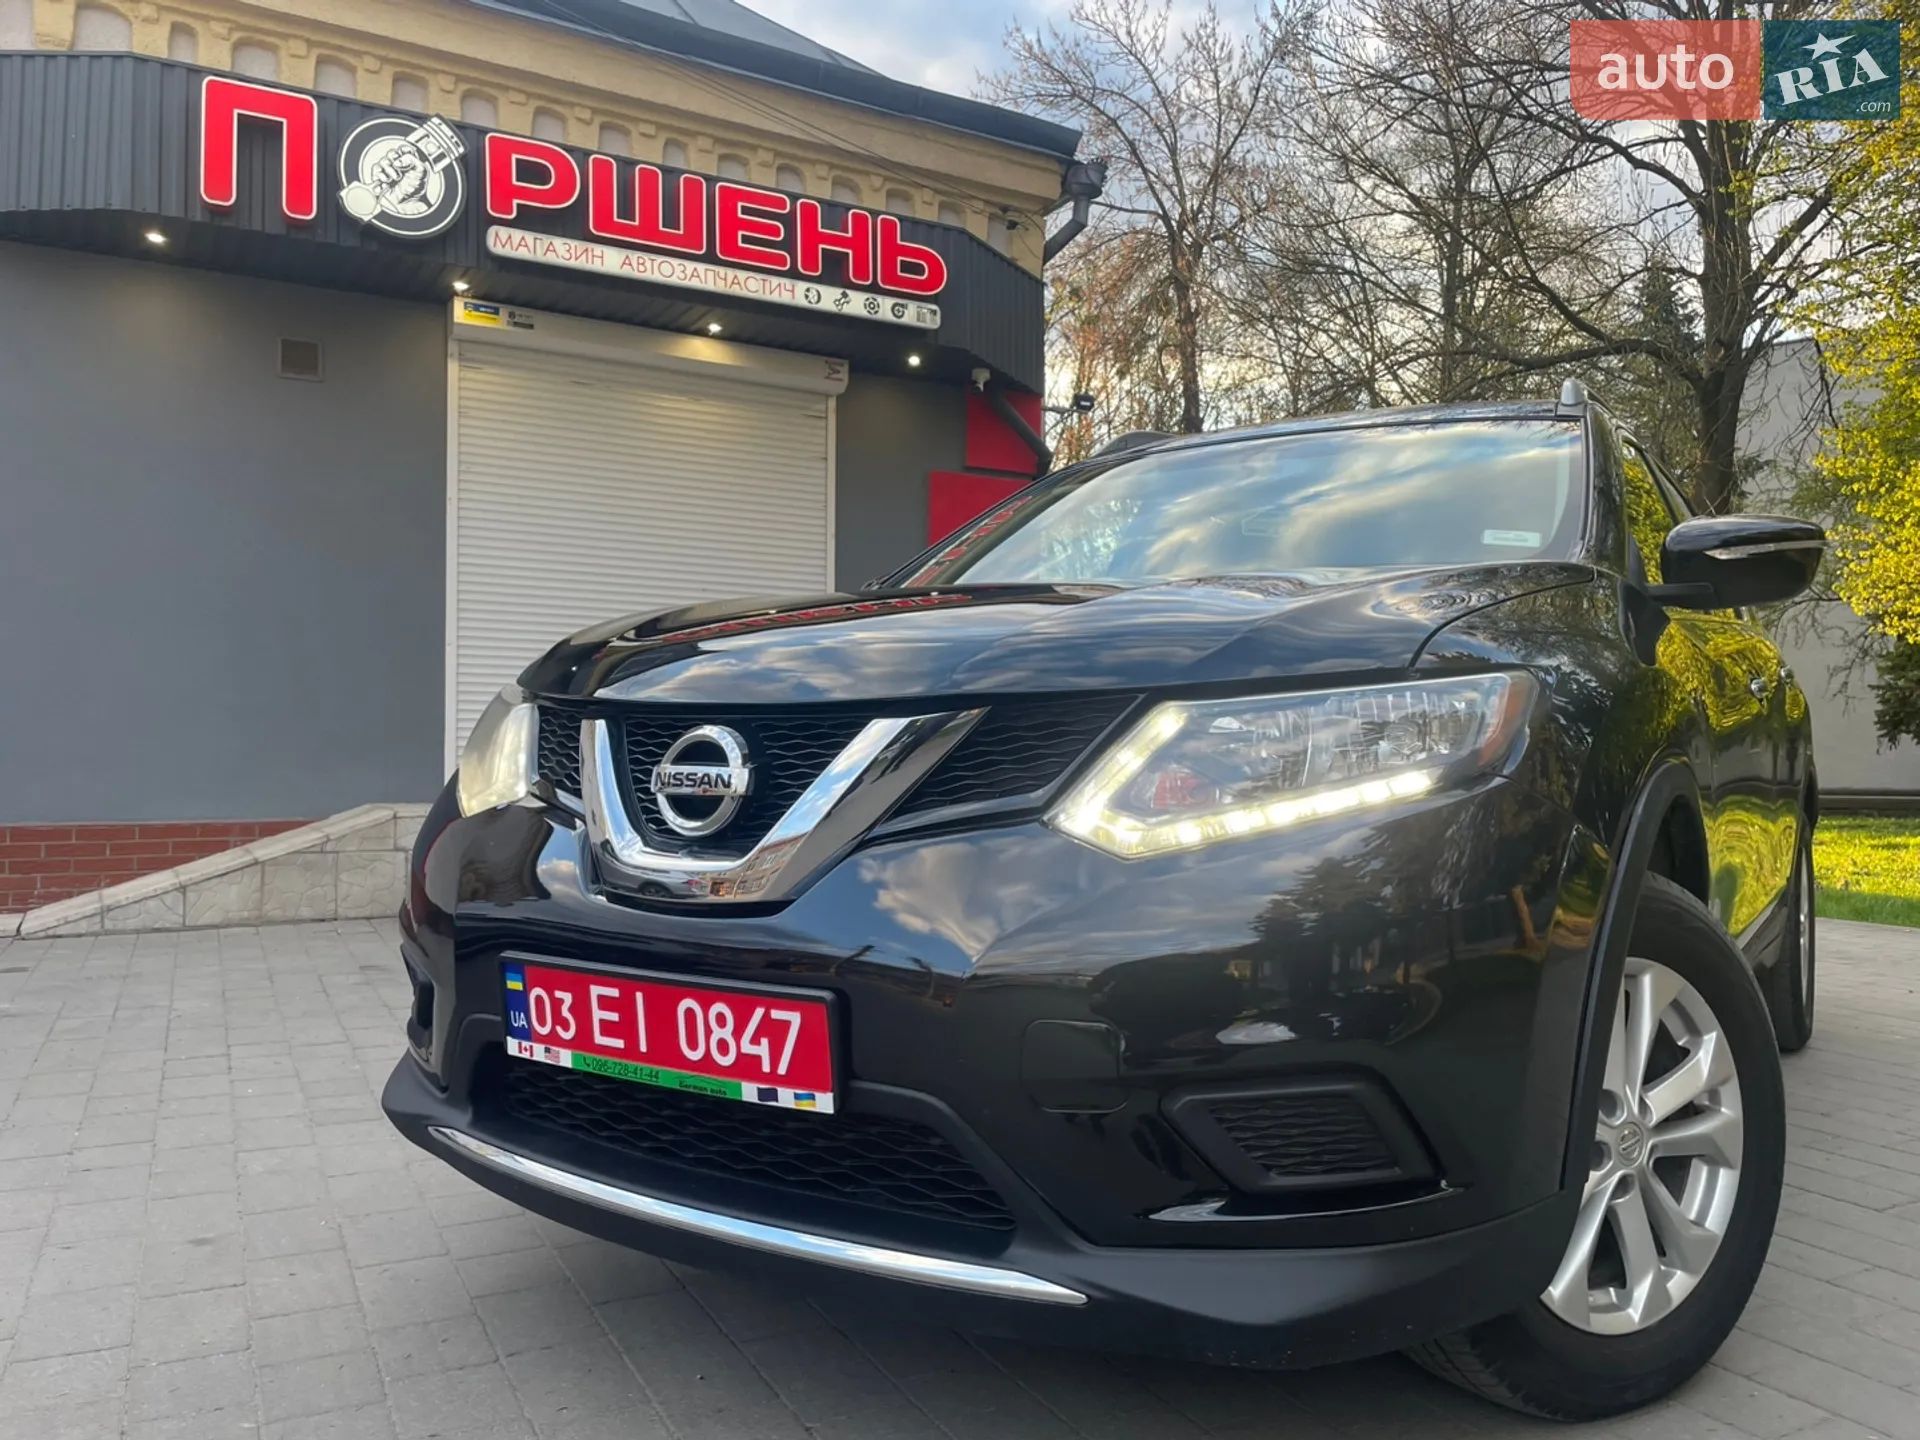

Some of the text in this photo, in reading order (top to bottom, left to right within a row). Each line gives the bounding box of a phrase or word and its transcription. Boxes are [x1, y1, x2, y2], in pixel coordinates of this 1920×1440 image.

[492, 230, 605, 267] МАГАЗИН
[654, 771, 732, 789] NISSAN
[510, 1010, 528, 1029] UA
[529, 986, 576, 1040] 03
[676, 998, 801, 1076] 0847
